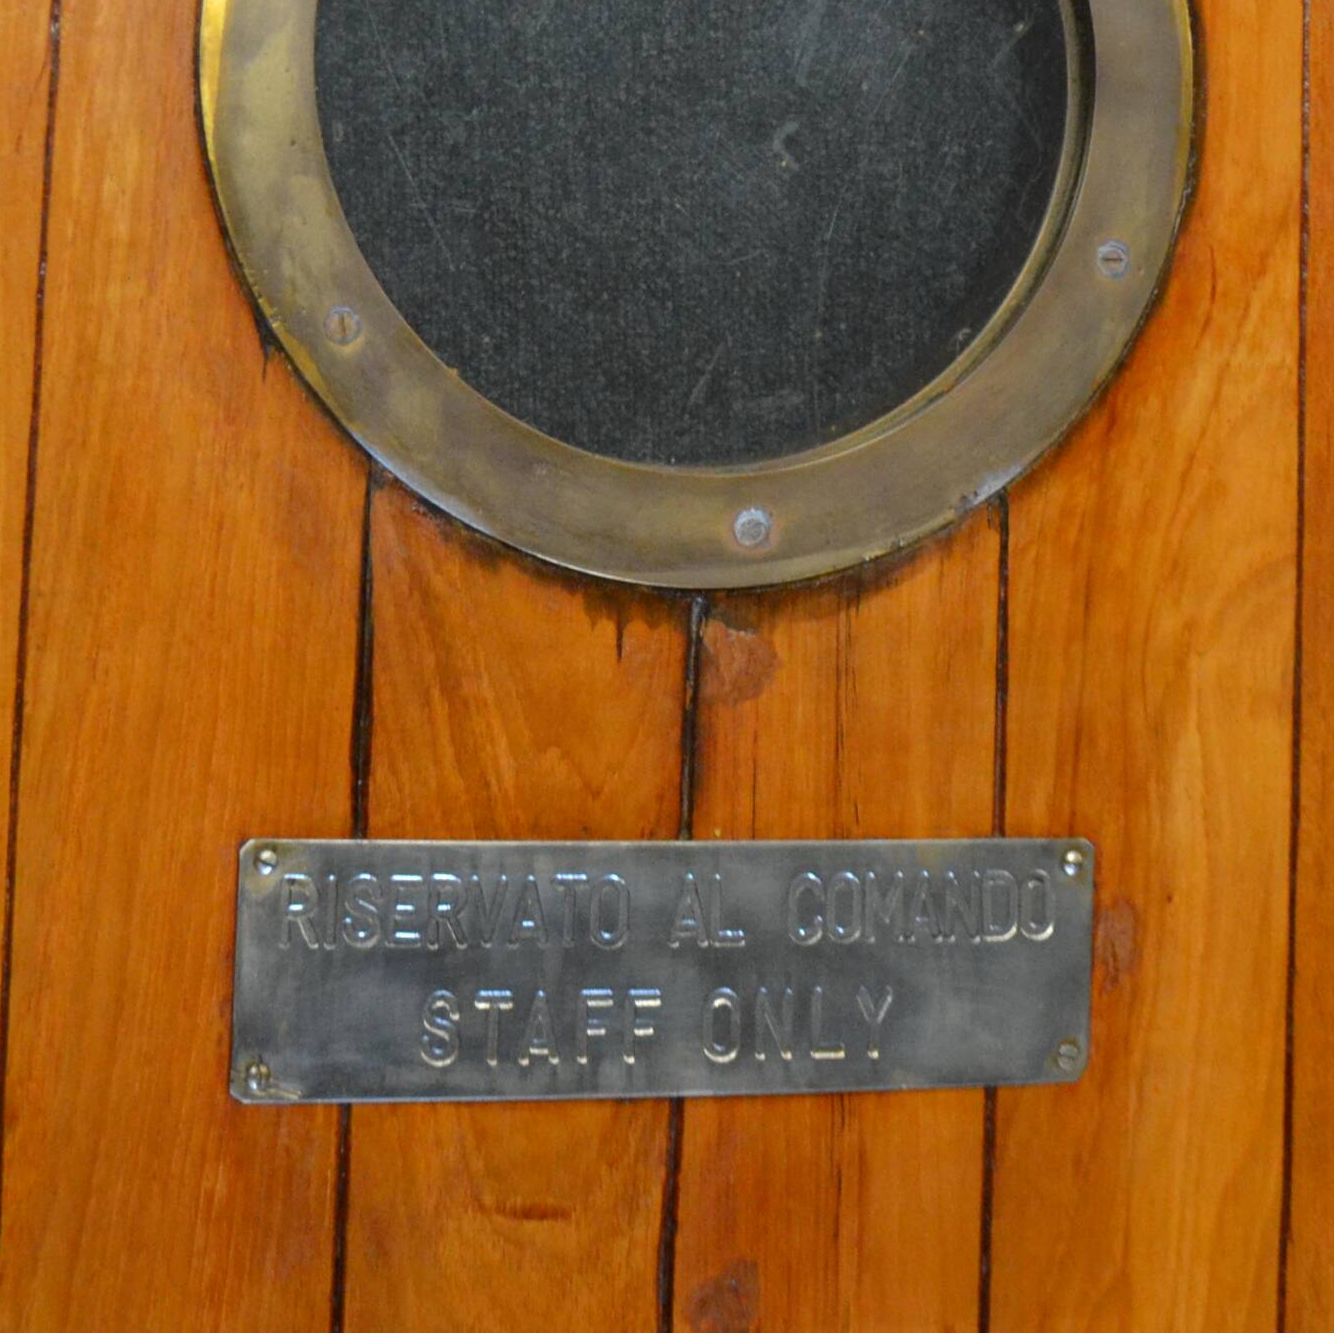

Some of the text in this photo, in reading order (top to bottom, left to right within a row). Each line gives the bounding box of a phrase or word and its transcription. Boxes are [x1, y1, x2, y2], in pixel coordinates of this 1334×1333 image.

[277, 869, 1057, 950] RISERVATO AL COMANDO
[420, 984, 895, 1066] STAFF ONLY
